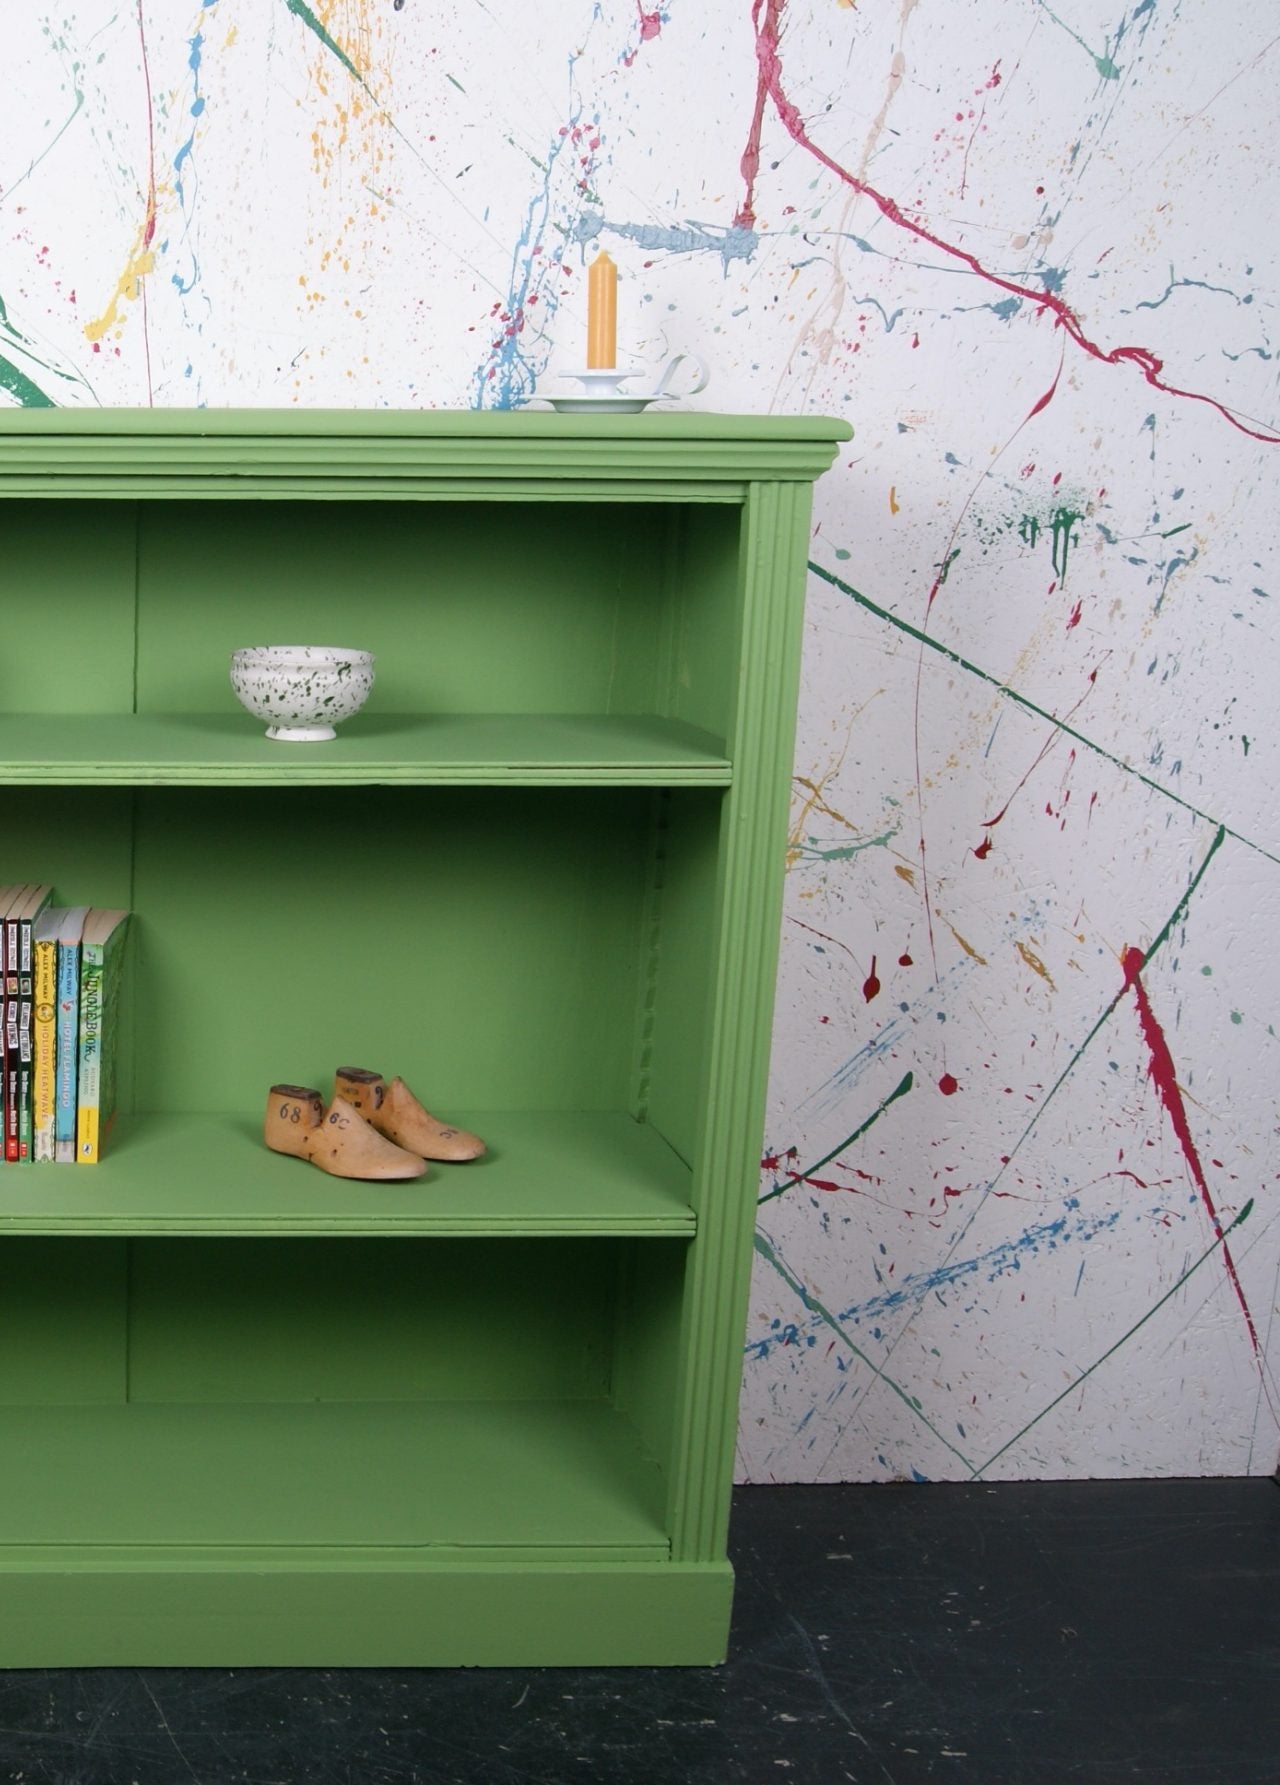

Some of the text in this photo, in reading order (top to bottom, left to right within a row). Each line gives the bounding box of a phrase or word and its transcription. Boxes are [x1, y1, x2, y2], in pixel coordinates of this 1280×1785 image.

[85, 972, 100, 1021] JUNGLE
[8, 1024, 17, 1045] VIKINGS
[41, 1026, 49, 1067] HOLIDAY
[85, 1022, 97, 1058] BOOK
[62, 1021, 72, 1108] HOTEL FLAMINGO
[280, 1102, 301, 1124] 68
